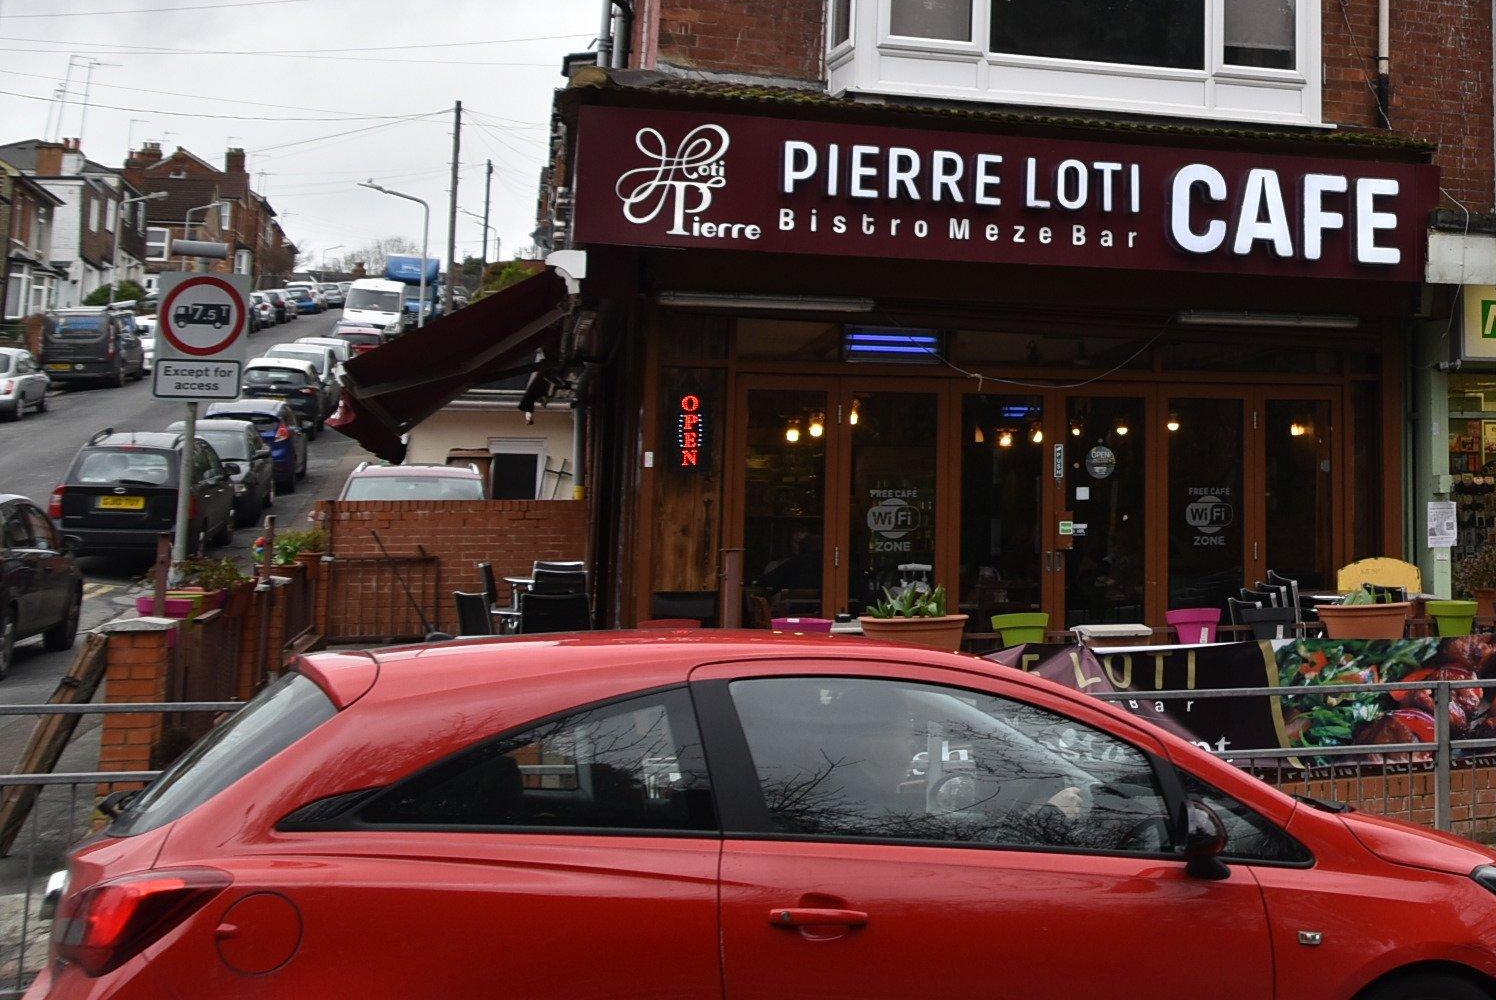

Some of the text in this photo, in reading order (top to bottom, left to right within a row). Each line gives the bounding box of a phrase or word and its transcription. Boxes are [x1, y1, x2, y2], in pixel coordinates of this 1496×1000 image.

[784, 140, 1140, 213] PIERRE LOTI
[666, 180, 762, 241] Pierre
[779, 208, 1138, 248] Bistro Meze Bar
[1171, 163, 1401, 264] CAFE
[163, 366, 233, 379] Except for
[174, 382, 219, 391] access
[681, 395, 699, 466] OPEN
[875, 541, 911, 551] ZONE
[1194, 536, 1225, 545] ZONE
